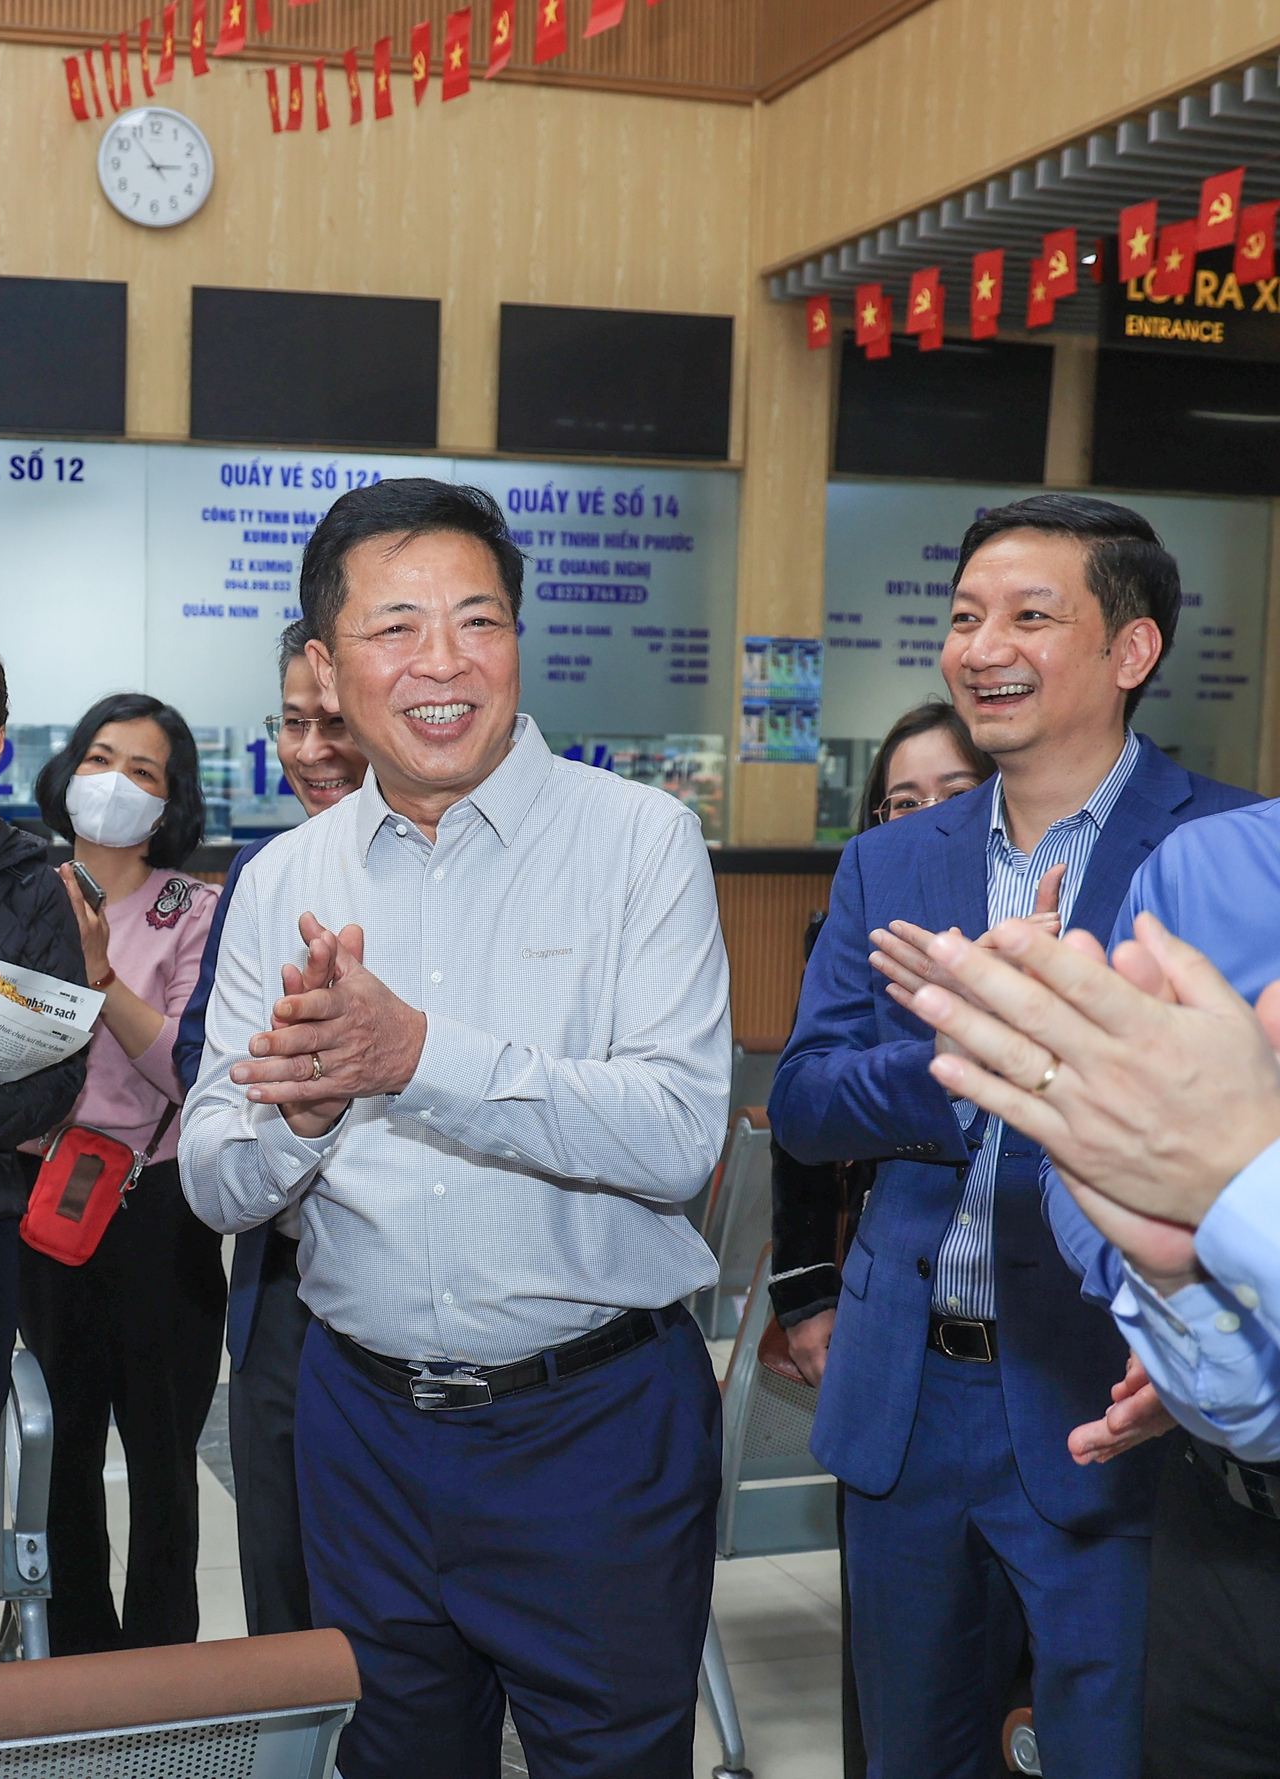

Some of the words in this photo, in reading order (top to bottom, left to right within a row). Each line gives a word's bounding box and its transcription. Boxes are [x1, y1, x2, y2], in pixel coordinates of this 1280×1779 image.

[132, 125, 143, 138] 11
[150, 120, 163, 135] 12
[172, 127, 178, 141] 1
[118, 137, 131, 151] 10
[185, 142, 195, 158] 2
[111, 156, 120, 171] 9
[190, 162, 198, 178] 3
[118, 177, 127, 192] 8
[184, 182, 193, 196] 4
[132, 192, 141, 206] 7
[150, 199, 159, 214] 6
[170, 195, 178, 209] 5
[1195, 269, 1245, 310] RA
[1125, 314, 1225, 344] ENTRANCE
[11, 448, 43, 481] SỐ
[54, 458, 84, 482] 12
[280, 462, 303, 487] VÉ
[312, 460, 337, 489] SỐ
[578, 486, 605, 516] VÉ
[613, 484, 645, 517] SỐ
[652, 494, 680, 518] 14
[202, 507, 236, 523] CÔNG
[240, 509, 254, 523] TY
[258, 510, 289, 524] TNHH
[243, 529, 288, 544] KUMHO
[538, 530, 556, 547] TY
[561, 531, 600, 548] TNHH
[229, 558, 244, 571] XE
[249, 559, 293, 573] KUMHO
[536, 559, 553, 574] XE
[54, 1007, 76, 1020] sạch
